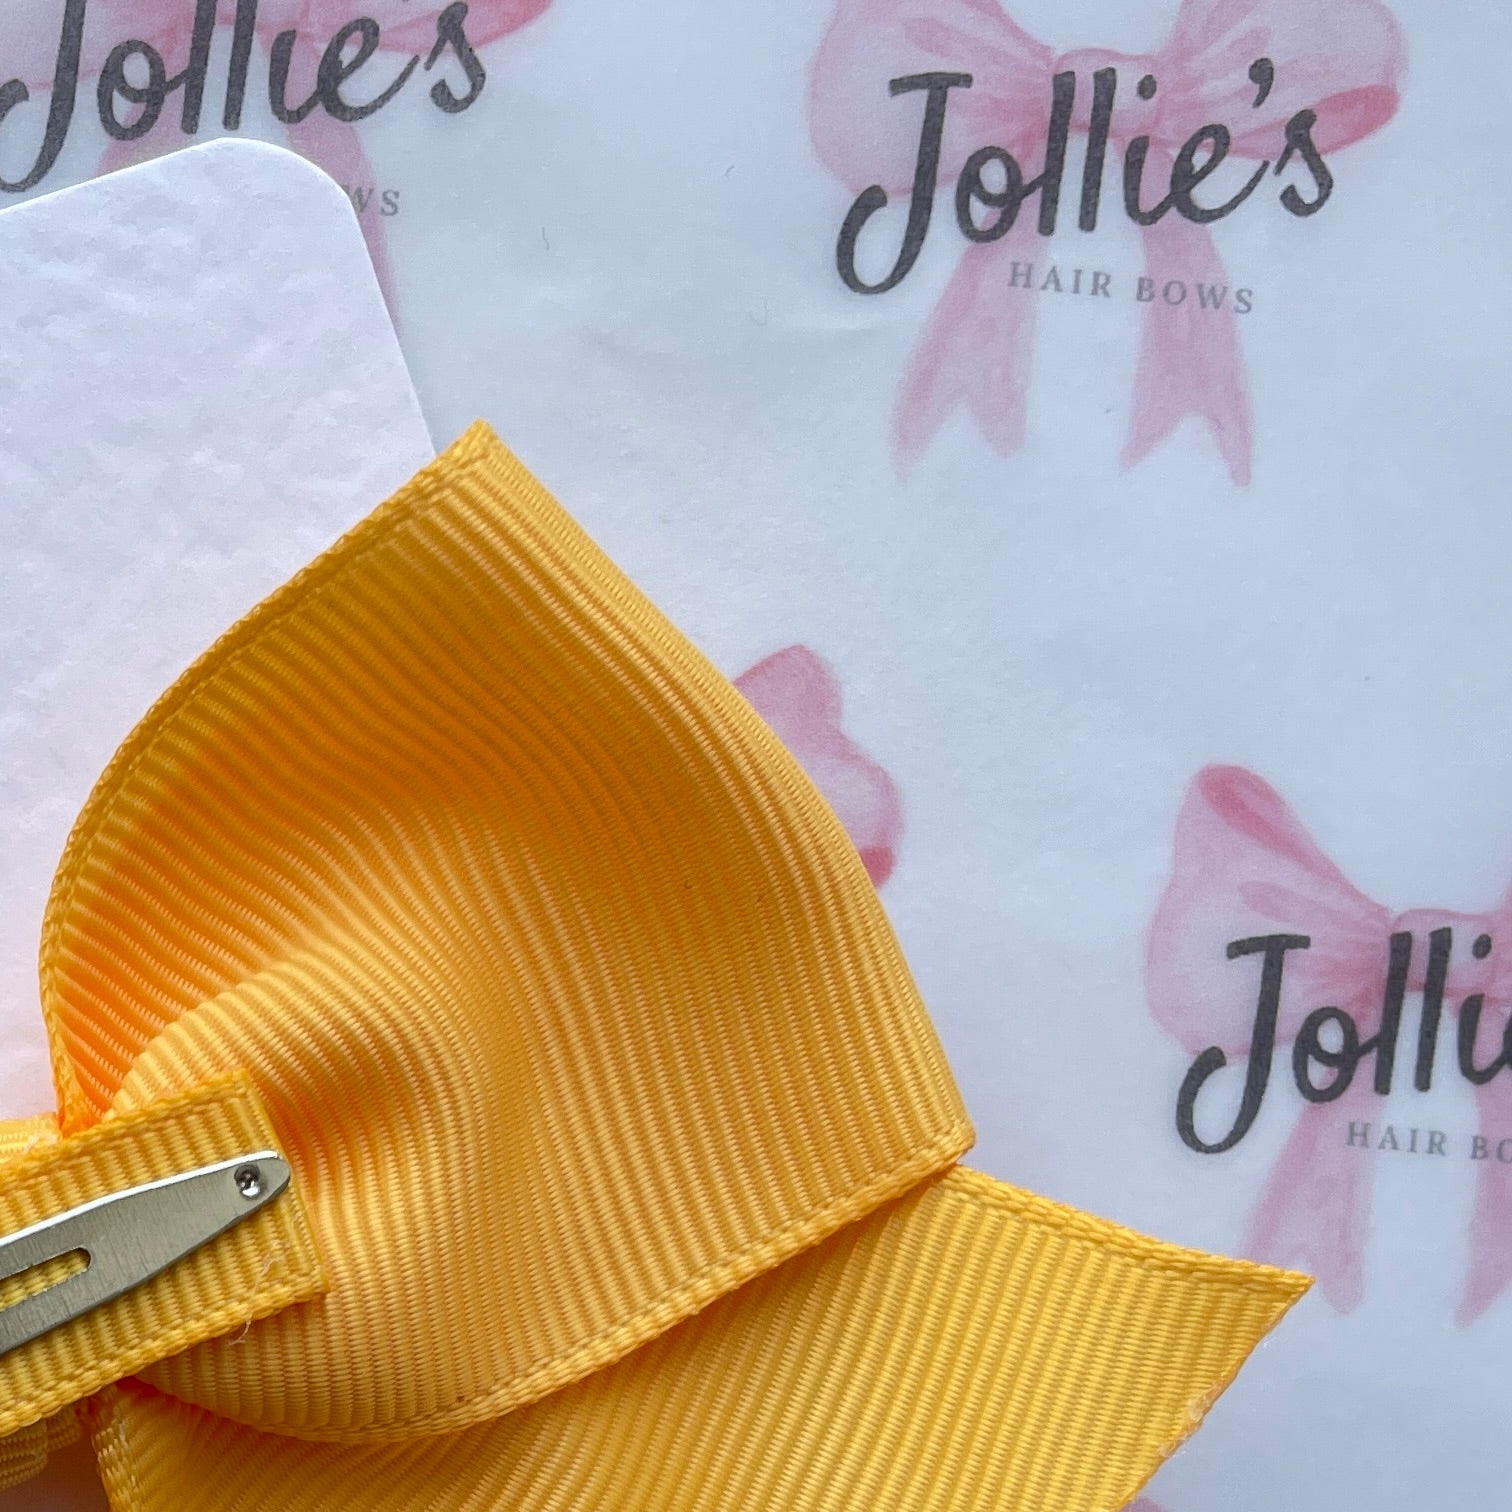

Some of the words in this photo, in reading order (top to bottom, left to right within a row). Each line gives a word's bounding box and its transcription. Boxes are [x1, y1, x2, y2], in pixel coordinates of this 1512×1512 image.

[837, 58, 1333, 294] Jollie's
[1007, 261, 1113, 299] HAIR
[1135, 276, 1254, 314] BOWS
[1176, 927, 1512, 1154] Jolli
[1345, 1121, 1448, 1157] HAIR
[1470, 1135, 1512, 1165] BO
